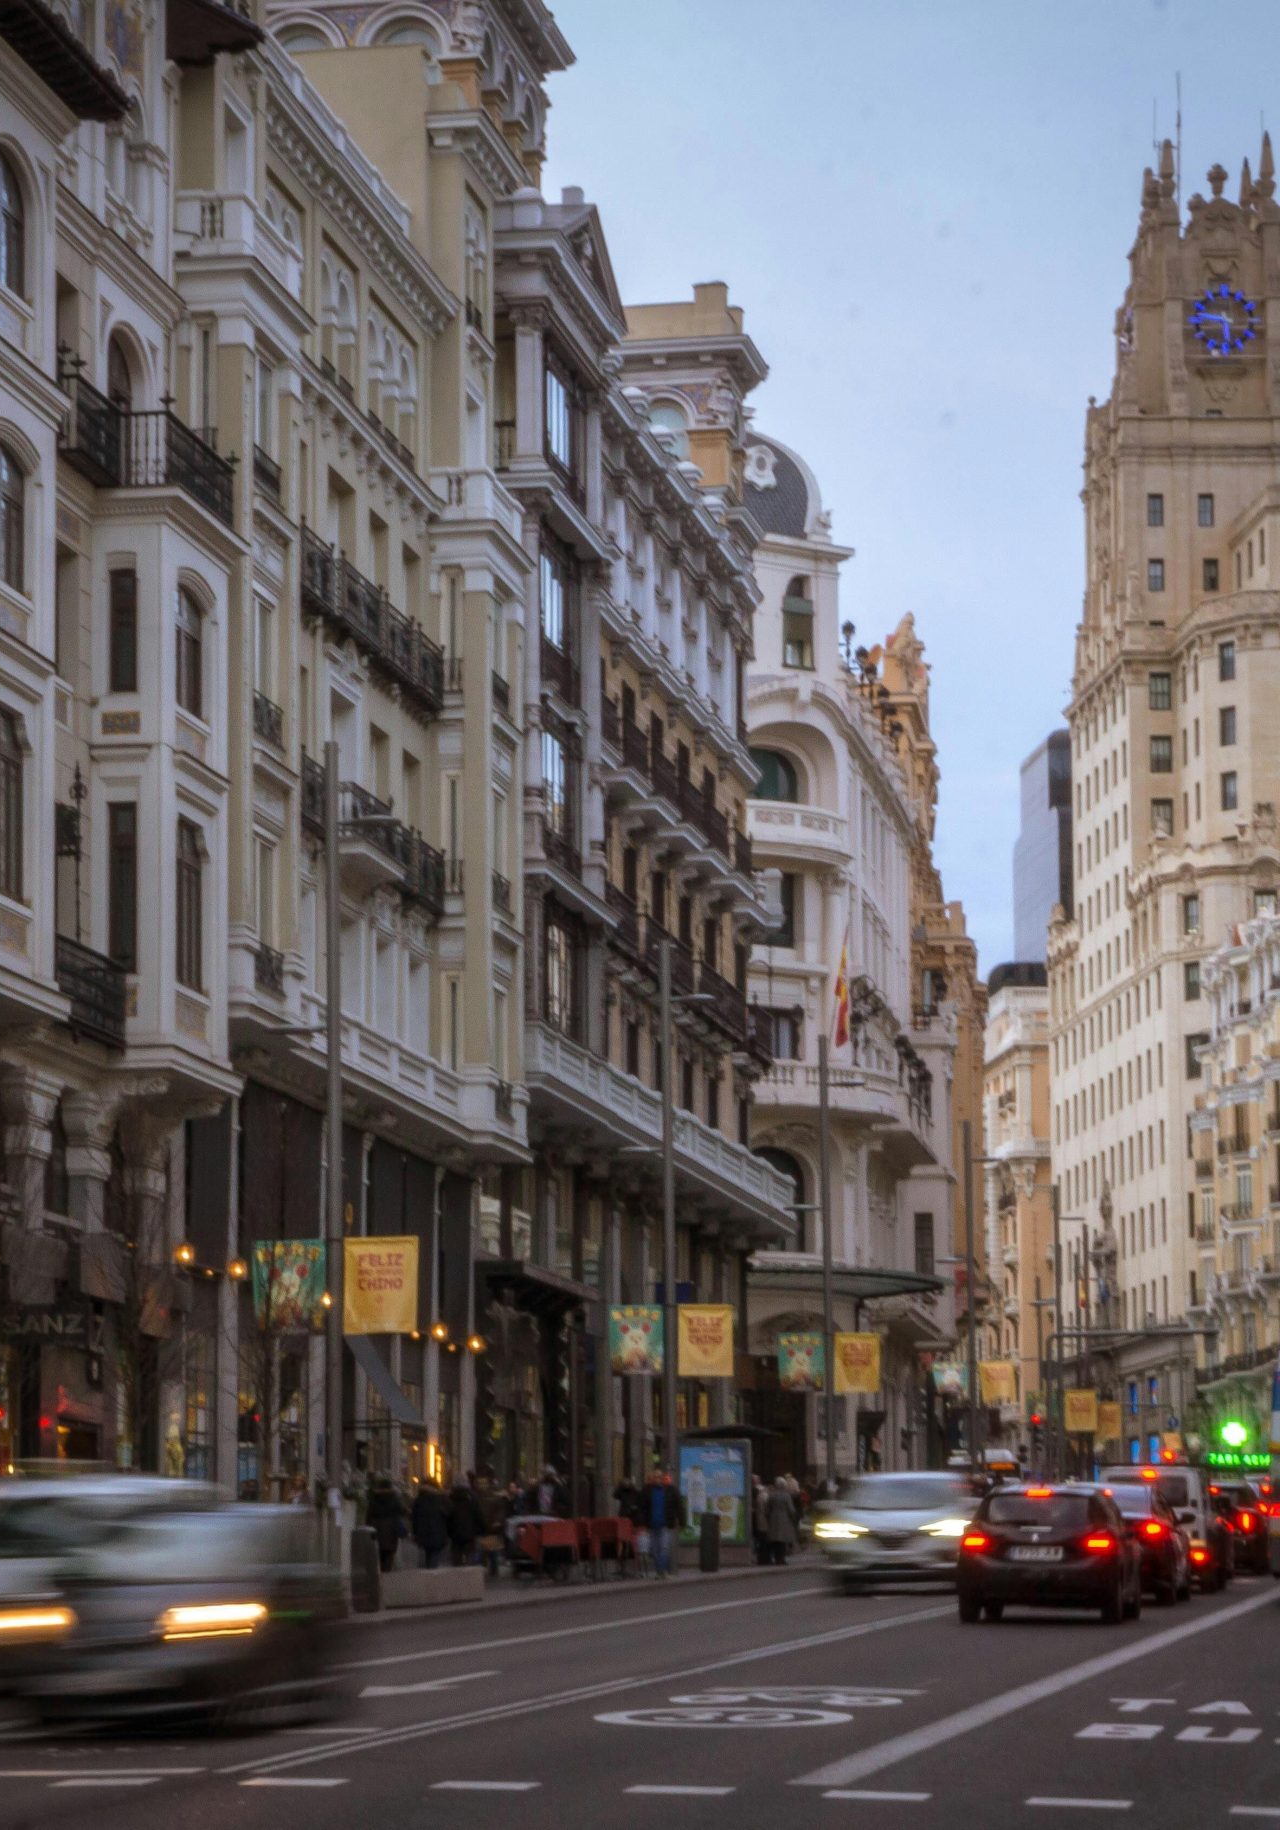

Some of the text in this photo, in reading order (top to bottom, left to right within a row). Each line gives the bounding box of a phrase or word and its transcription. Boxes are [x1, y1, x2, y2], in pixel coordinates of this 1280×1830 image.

[3, 1313, 84, 1335] SANZ
[654, 1710, 795, 1722] 30
[1110, 1697, 1280, 1716] TA
[1073, 1722, 1280, 1744] BU
